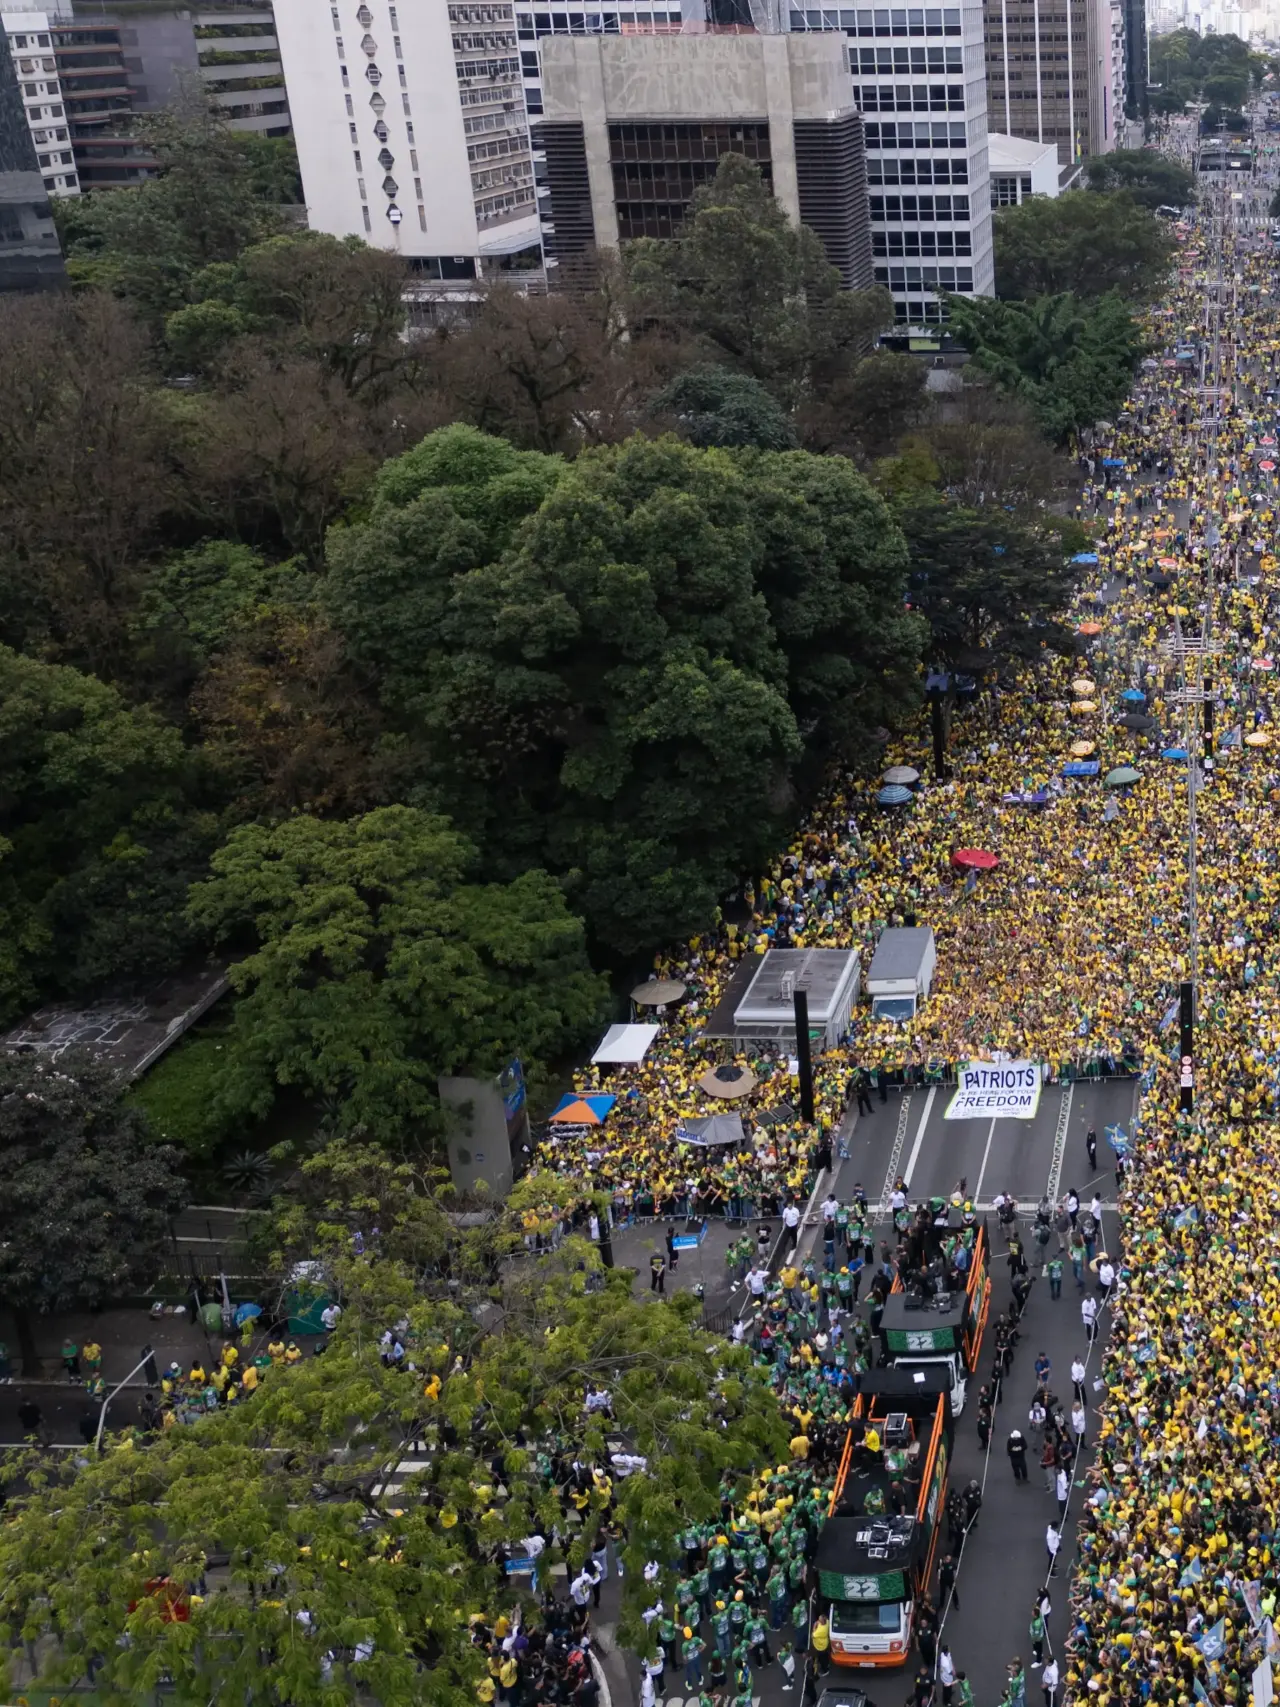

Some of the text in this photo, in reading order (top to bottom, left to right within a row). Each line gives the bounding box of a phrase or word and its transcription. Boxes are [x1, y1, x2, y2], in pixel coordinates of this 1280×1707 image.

[964, 1068, 1034, 1090] PATRIOTS
[955, 1095, 1032, 1108] FREEDOM
[908, 1337, 933, 1350] 22
[845, 1582, 879, 1597] 22
